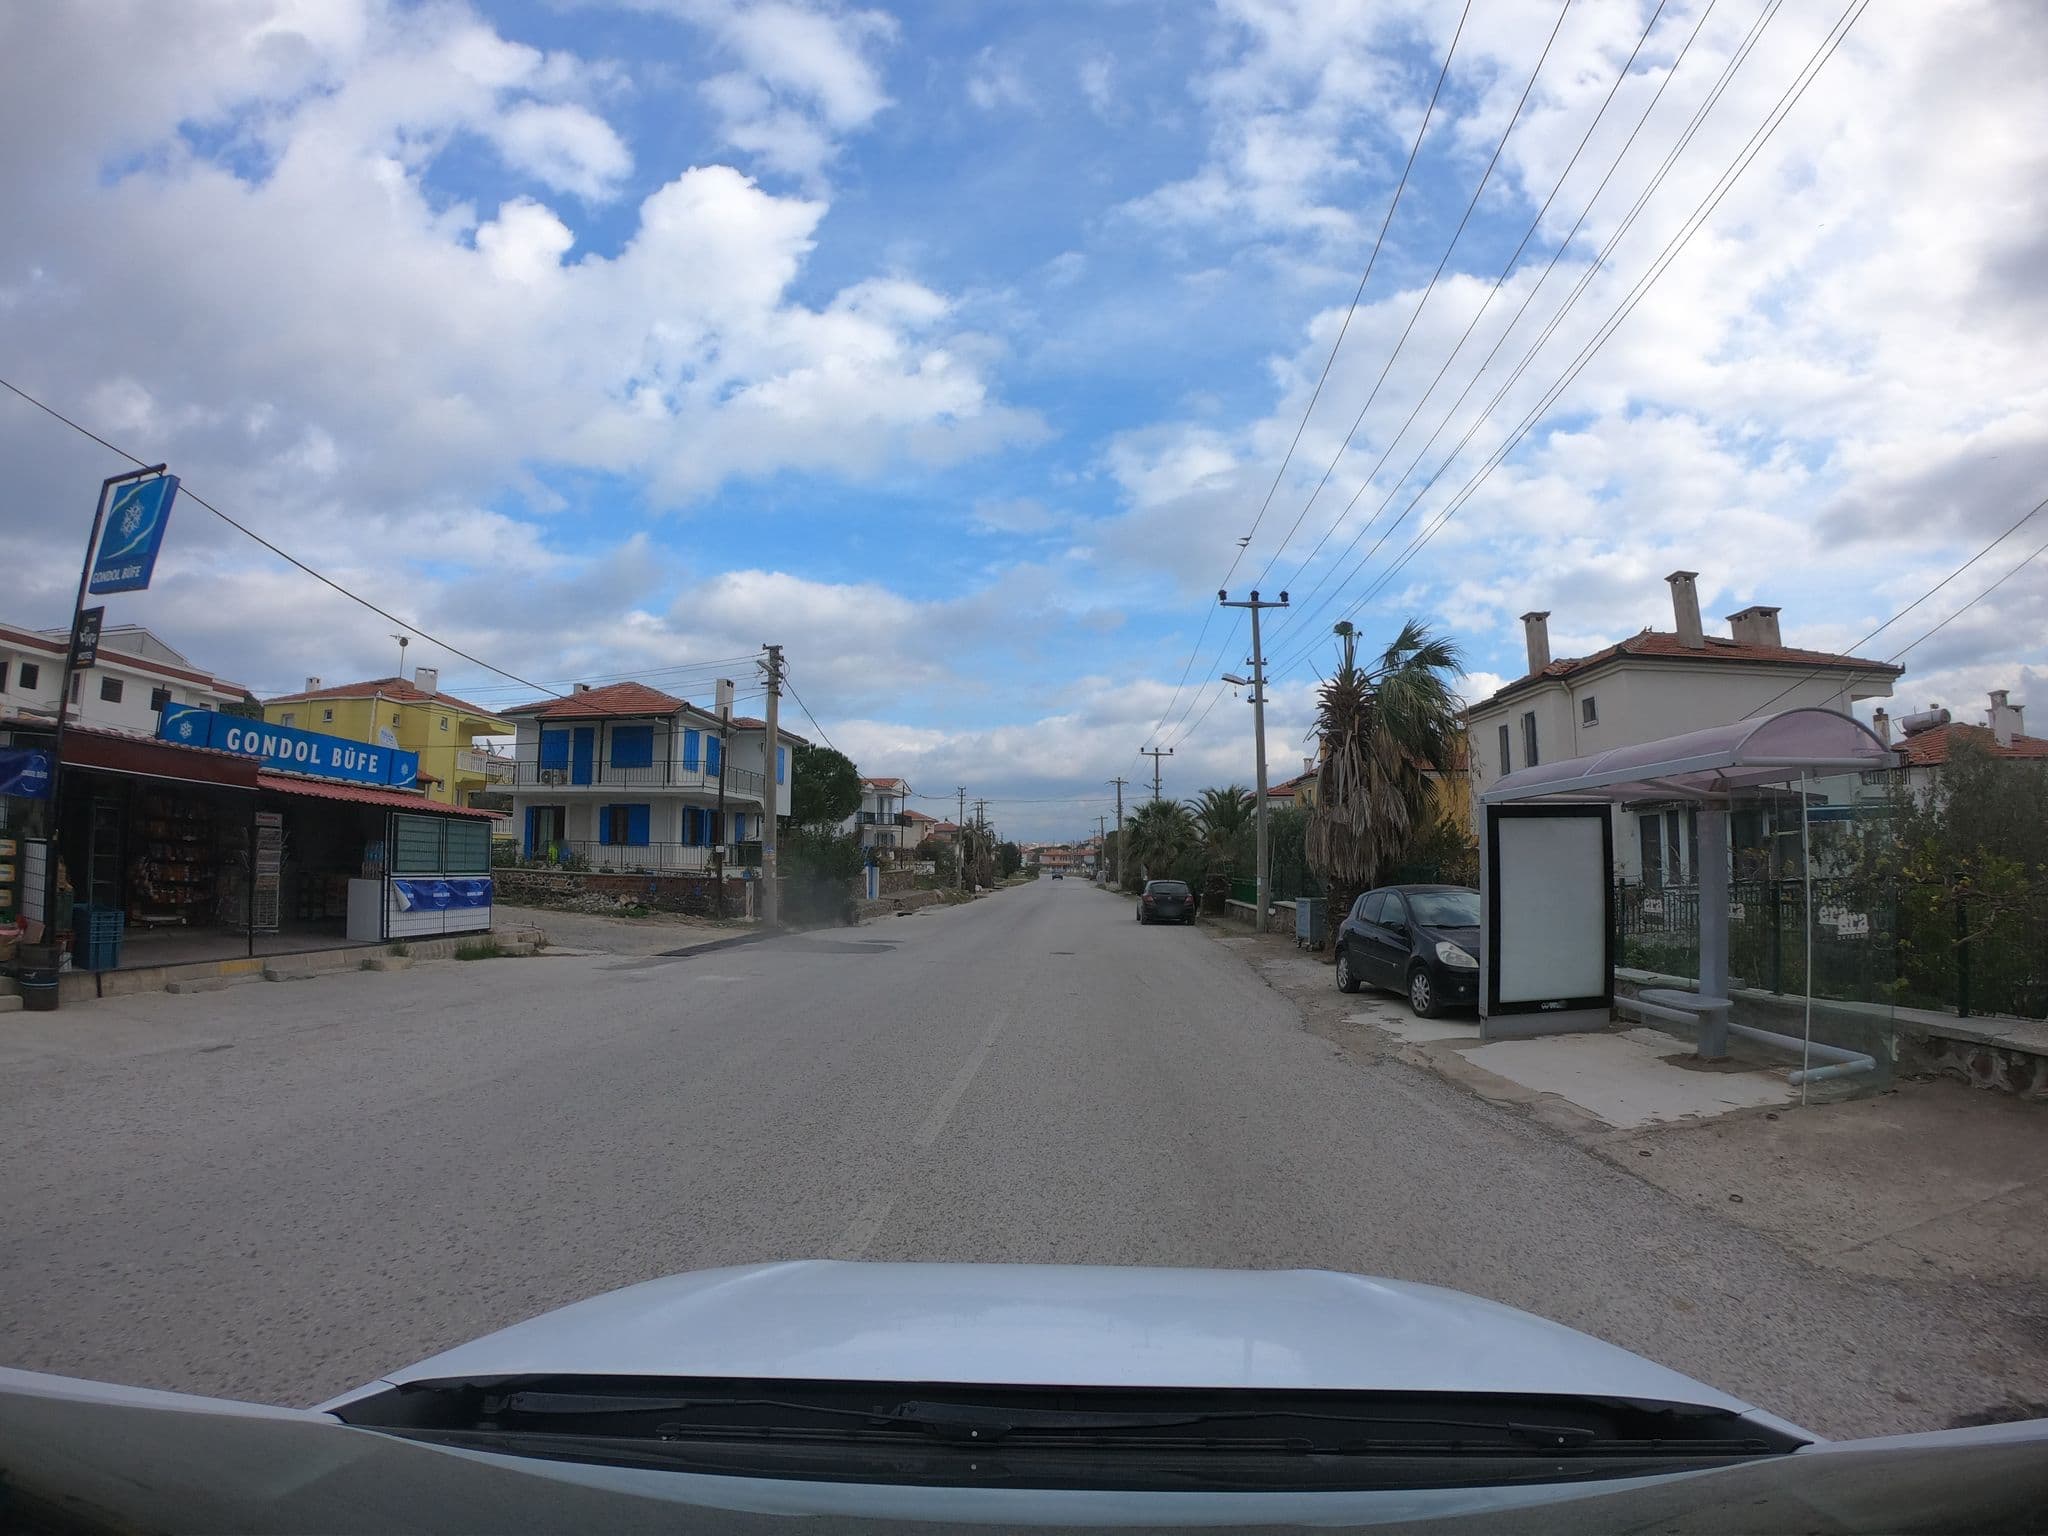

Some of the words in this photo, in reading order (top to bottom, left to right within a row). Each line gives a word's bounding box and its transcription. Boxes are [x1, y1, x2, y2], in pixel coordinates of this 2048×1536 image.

[92, 568, 121, 584] GONDOL
[121, 564, 142, 580] BÜFE
[227, 728, 321, 764] GONDOL
[331, 747, 379, 773] BÜFE
[1727, 902, 1745, 919] ra
